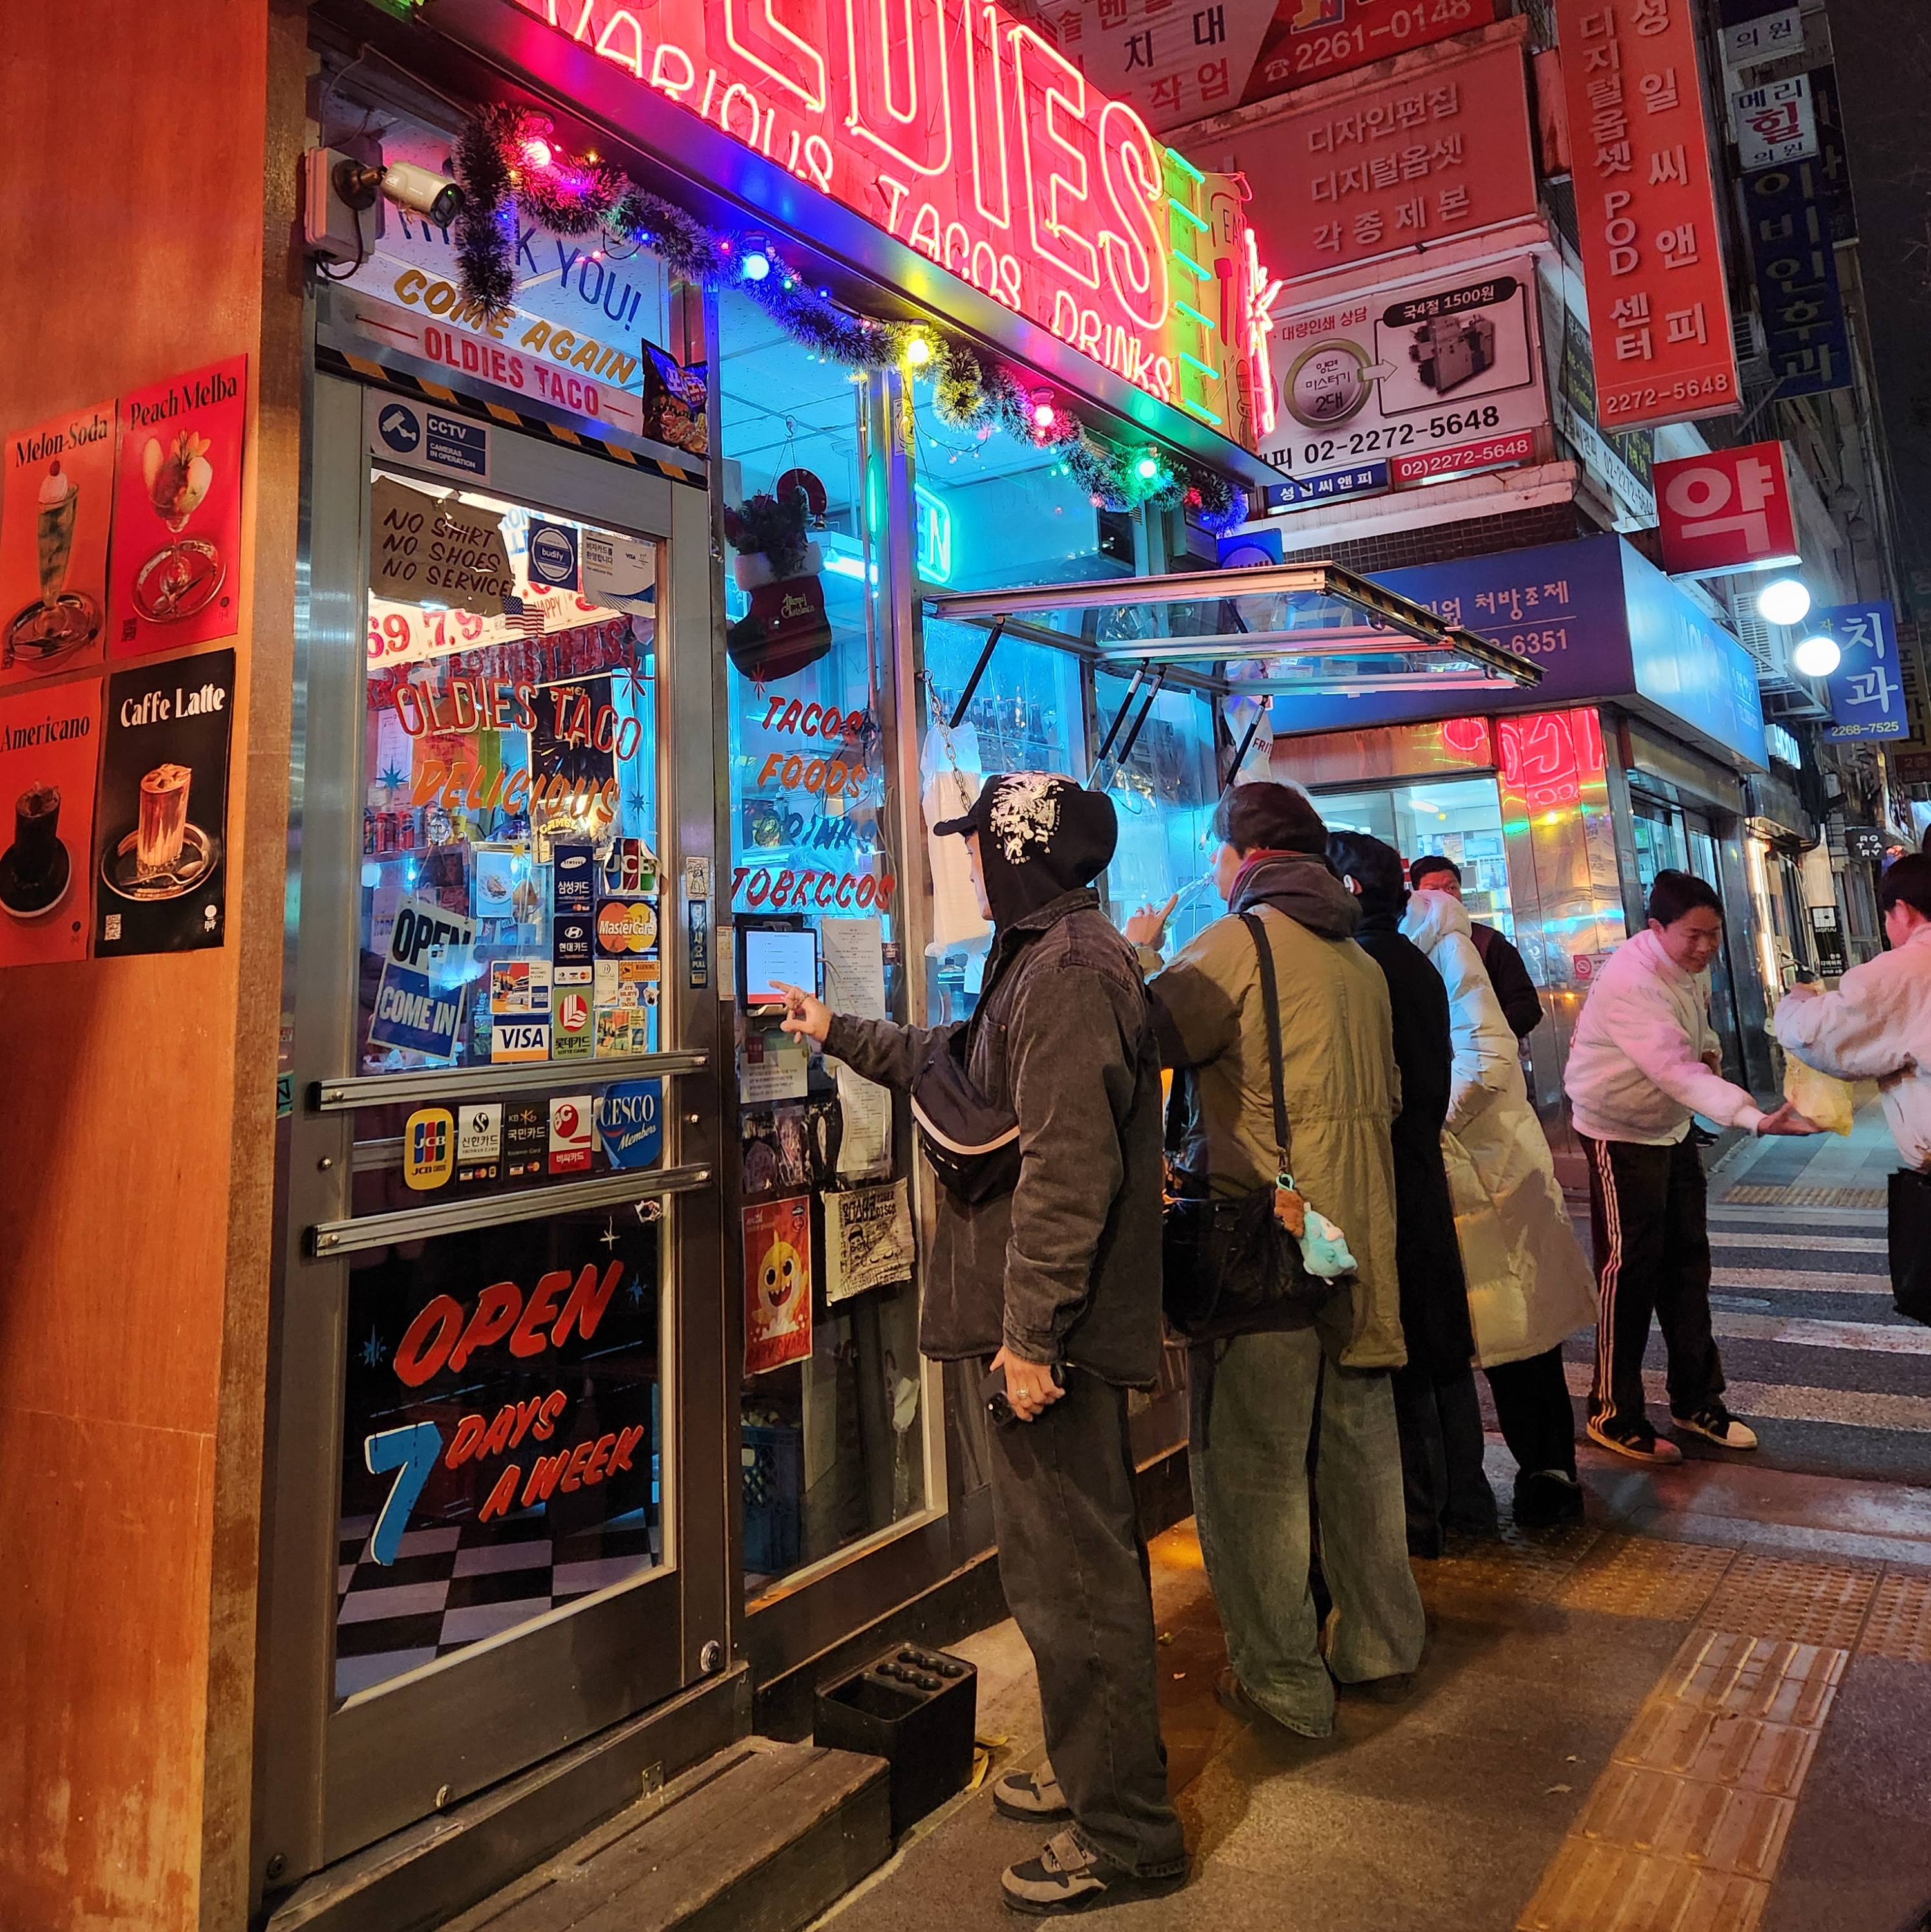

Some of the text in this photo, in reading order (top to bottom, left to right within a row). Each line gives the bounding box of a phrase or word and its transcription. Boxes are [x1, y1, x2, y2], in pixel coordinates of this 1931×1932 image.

[1295, 0, 1471, 73] 2261-0148
[1737, 19, 1791, 48] 의원
[1109, 57, 1229, 111] 작업
[1738, 79, 1802, 109] 메리
[1307, 81, 1459, 153] 디자인편집
[1745, 101, 1804, 144] 힐
[1311, 131, 1463, 203] 디지털옵셋
[1755, 141, 1803, 161] 의원
[1580, 4, 1652, 361] 디지털옵셋 POD 센터
[1630, 0, 1707, 345] 성일씨앤피
[555, 239, 643, 332] YOU!
[878, 175, 1021, 310] TACOS
[1053, 291, 1173, 402] DRINKS
[1754, 162, 1839, 382] 이비인후과
[1403, 285, 1494, 321] 국4절 1500원
[1282, 306, 1368, 341] 대량인쇄 상담
[424, 326, 599, 416] OLDIES TACO
[520, 319, 637, 385] AGAIN
[1315, 360, 1339, 375] 양면
[130, 373, 238, 431] Peach Melba
[1315, 385, 1344, 413] 2대
[1606, 374, 1728, 414] 2272-5648
[15, 414, 108, 468] Melon Soda
[428, 417, 467, 440] CCTV
[1305, 406, 1500, 465] 02-2272-5648
[429, 442, 462, 458] CAMERAS
[429, 450, 476, 469] IN OPERATION
[1400, 439, 1529, 477] 02)2272-5648
[1666, 457, 1775, 554] 약
[382, 507, 424, 534] NO
[430, 517, 495, 549] SHIRT
[382, 532, 501, 574] NO SHOES
[586, 541, 613, 556] 비자카드를
[586, 550, 613, 565] 환영합니다
[381, 556, 513, 599] NO SERVICE
[1475, 580, 1570, 620] 처방조제
[1840, 612, 1899, 713] 치과
[120, 682, 225, 727] Caffe Latte
[550, 686, 588, 702] CMEL
[0, 715, 90, 753] Americano
[391, 677, 538, 738] OLDIES
[550, 686, 643, 762] TACO
[762, 695, 863, 744] TACOS
[1832, 720, 1899, 736] 2268-7525
[411, 760, 619, 823] DELICIOUS
[757, 752, 867, 798] FOODS
[605, 854, 654, 874] JCB
[558, 881, 590, 894] 삼성카드
[731, 867, 896, 909] TOBACCOS
[559, 942, 589, 952] 현대카드
[599, 920, 654, 935] MasterCard
[378, 986, 430, 1031] COME
[432, 1002, 455, 1036] IN
[500, 1027, 544, 1049] VISA
[555, 1036, 591, 1049] 롯데카드
[508, 1114, 519, 1123] KB
[600, 1094, 655, 1127] CESCO
[414, 1136, 446, 1149] JCB
[461, 1134, 499, 1149] 신한카드
[507, 1126, 545, 1141] 국민카드
[617, 1123, 657, 1152] Members
[876, 1203, 896, 1219] DISCO
[393, 1259, 625, 1387] OPEN
[364, 1389, 567, 1566] 7 DAYS
[478, 1425, 644, 1523] A WEEK
